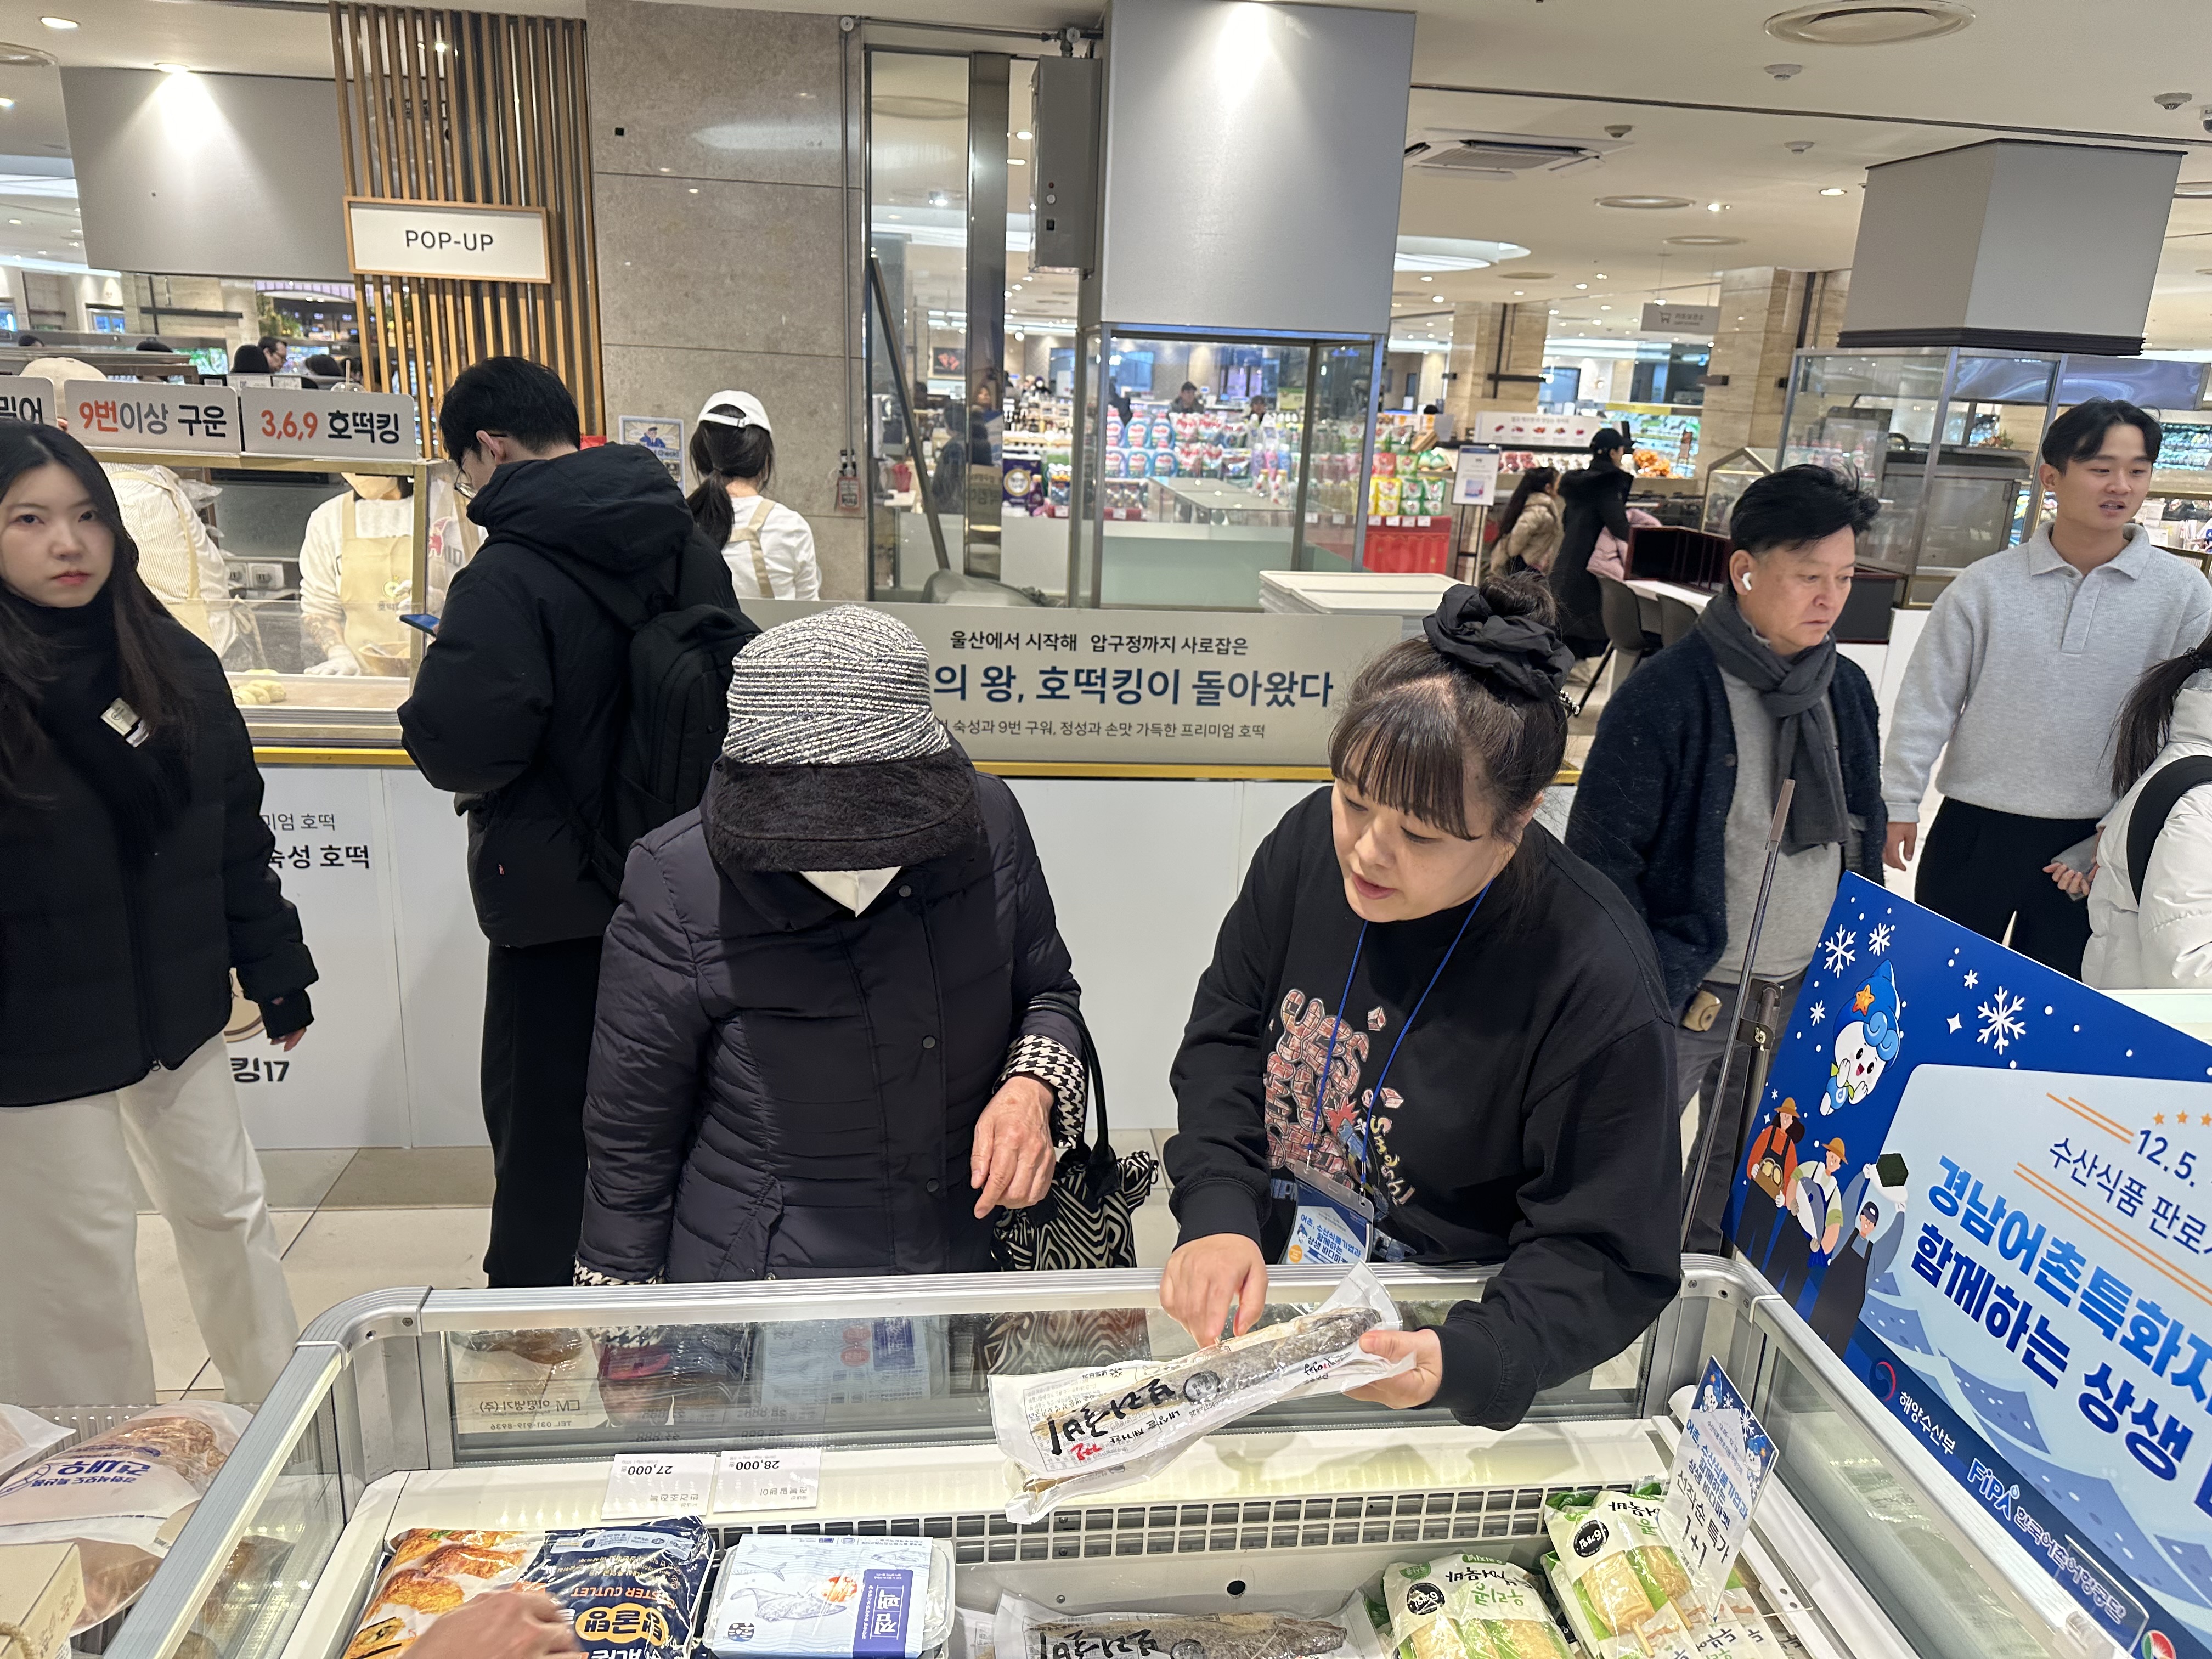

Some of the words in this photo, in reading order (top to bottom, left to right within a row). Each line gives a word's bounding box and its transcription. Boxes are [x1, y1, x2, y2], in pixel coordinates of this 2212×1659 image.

[405, 230, 494, 251] POP-UP
[78, 400, 168, 435] 9번이상
[177, 404, 227, 437] 구운
[261, 409, 319, 441] 3,6,9
[328, 409, 400, 445] 호떡킹
[950, 631, 1020, 652] 울산에서
[1025, 633, 1077, 652] 시작해
[1090, 633, 1176, 654] 압구정까지
[1181, 635, 1249, 656] 사로잡은
[933, 664, 967, 702] 의
[980, 665, 1024, 705] 왕,
[1036, 665, 1180, 706] 호떡킹이
[1191, 670, 1334, 708] 돌아왔다
[952, 719, 995, 735] 숙성과
[998, 720, 1023, 735] 9번
[1025, 721, 1056, 737] 구워,
[1060, 722, 1102, 736] 정성과
[1105, 723, 1133, 738] 손맛
[1136, 724, 1177, 738] 가득한
[1180, 724, 1235, 739] 프리미엄
[1238, 725, 1266, 740] 호떡
[301, 814, 336, 832] 호떡
[320, 844, 370, 870] 호떡
[230, 1057, 290, 1083] 킹17
[2049, 1137, 2147, 1218] 수산식품
[2148, 1195, 2212, 1255] 판로
[1910, 1221, 2071, 1390] 함께하는
[2078, 1361, 2195, 1481] 상생
[1686, 1418, 1700, 1449] 어촌,
[1899, 1391, 1956, 1455] 해양수산부
[1689, 1458, 1703, 1485] 상생
[1702, 1480, 1730, 1531] 바다마켓
[1699, 1455, 1726, 1505] 함께하는
[1677, 1469, 1705, 1527] 선착순
[1707, 1517, 1729, 1565] 특가
[1681, 1513, 1707, 1567] 1+1
[570, 1587, 623, 1598] CUTLET
